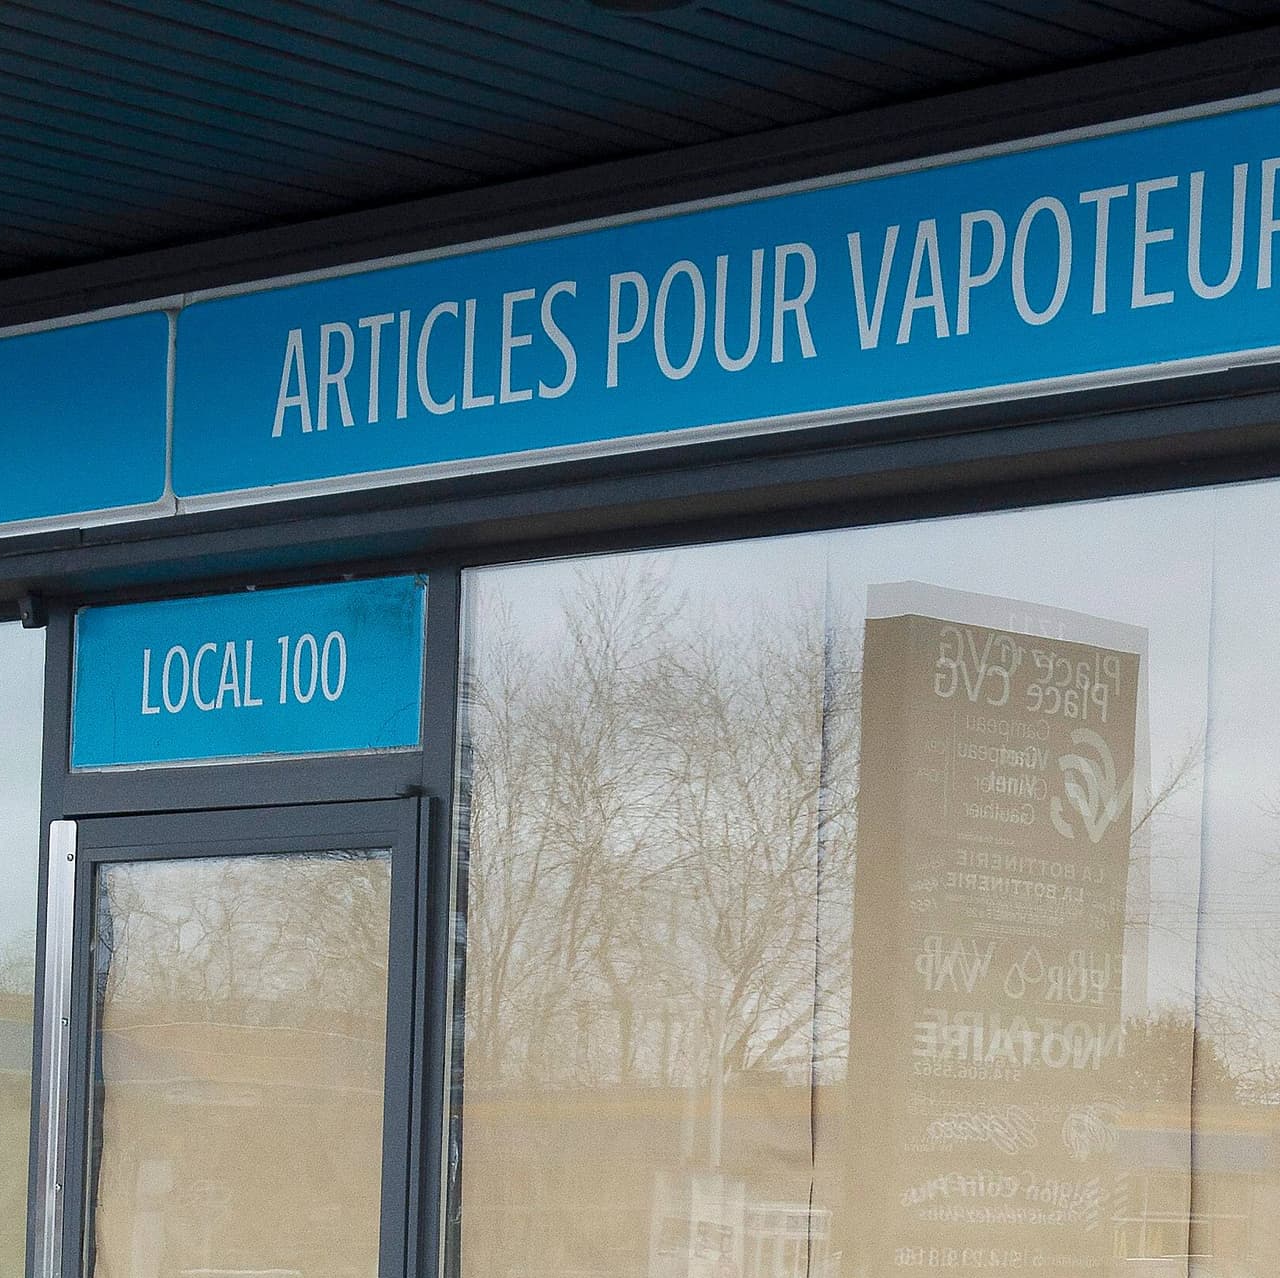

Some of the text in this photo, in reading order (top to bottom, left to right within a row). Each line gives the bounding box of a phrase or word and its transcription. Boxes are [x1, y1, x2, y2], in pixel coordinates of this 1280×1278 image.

[272, 281, 577, 438] ARTICLES
[606, 242, 817, 388] POUR
[142, 630, 347, 715] LOCAL 100
